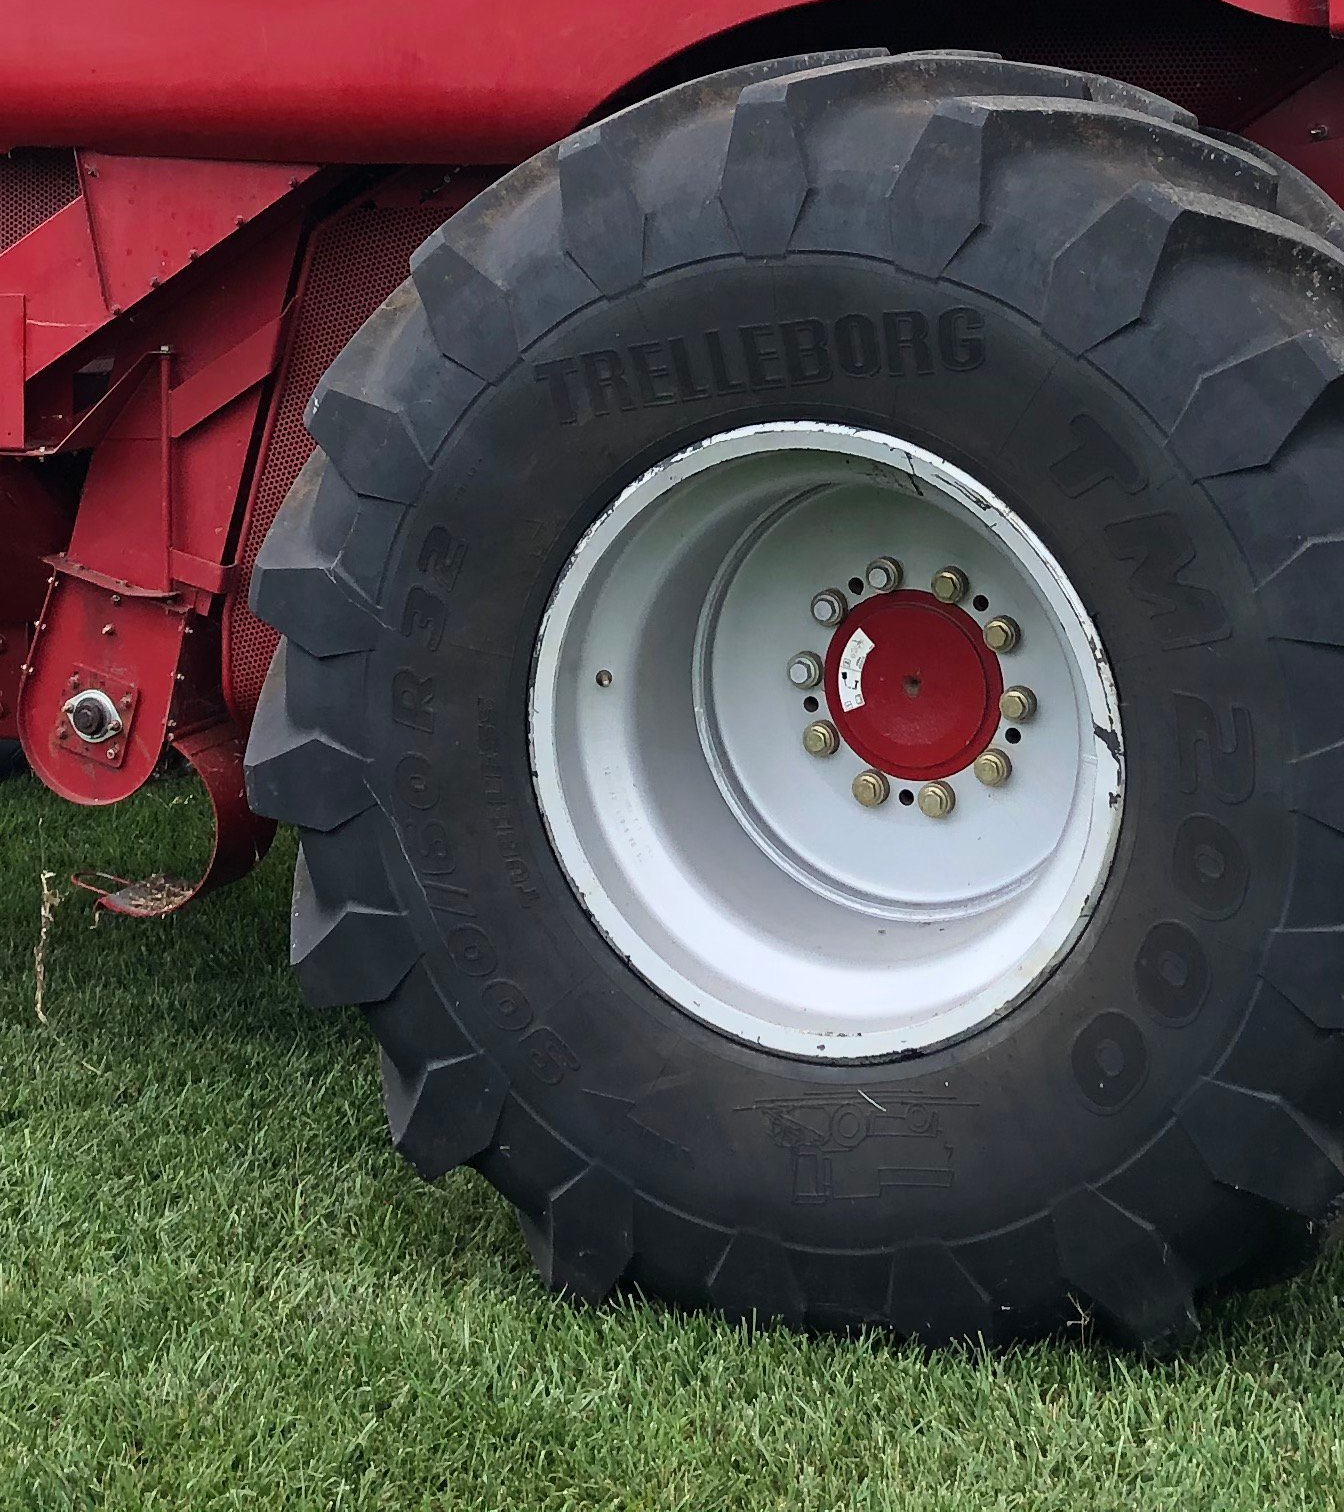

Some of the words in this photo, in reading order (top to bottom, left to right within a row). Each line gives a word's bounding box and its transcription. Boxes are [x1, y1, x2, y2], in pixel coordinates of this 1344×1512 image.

[533, 305, 987, 426] TRELLEBORG
[1049, 411, 1234, 652] TM
[1069, 690, 1256, 1116] 2000
